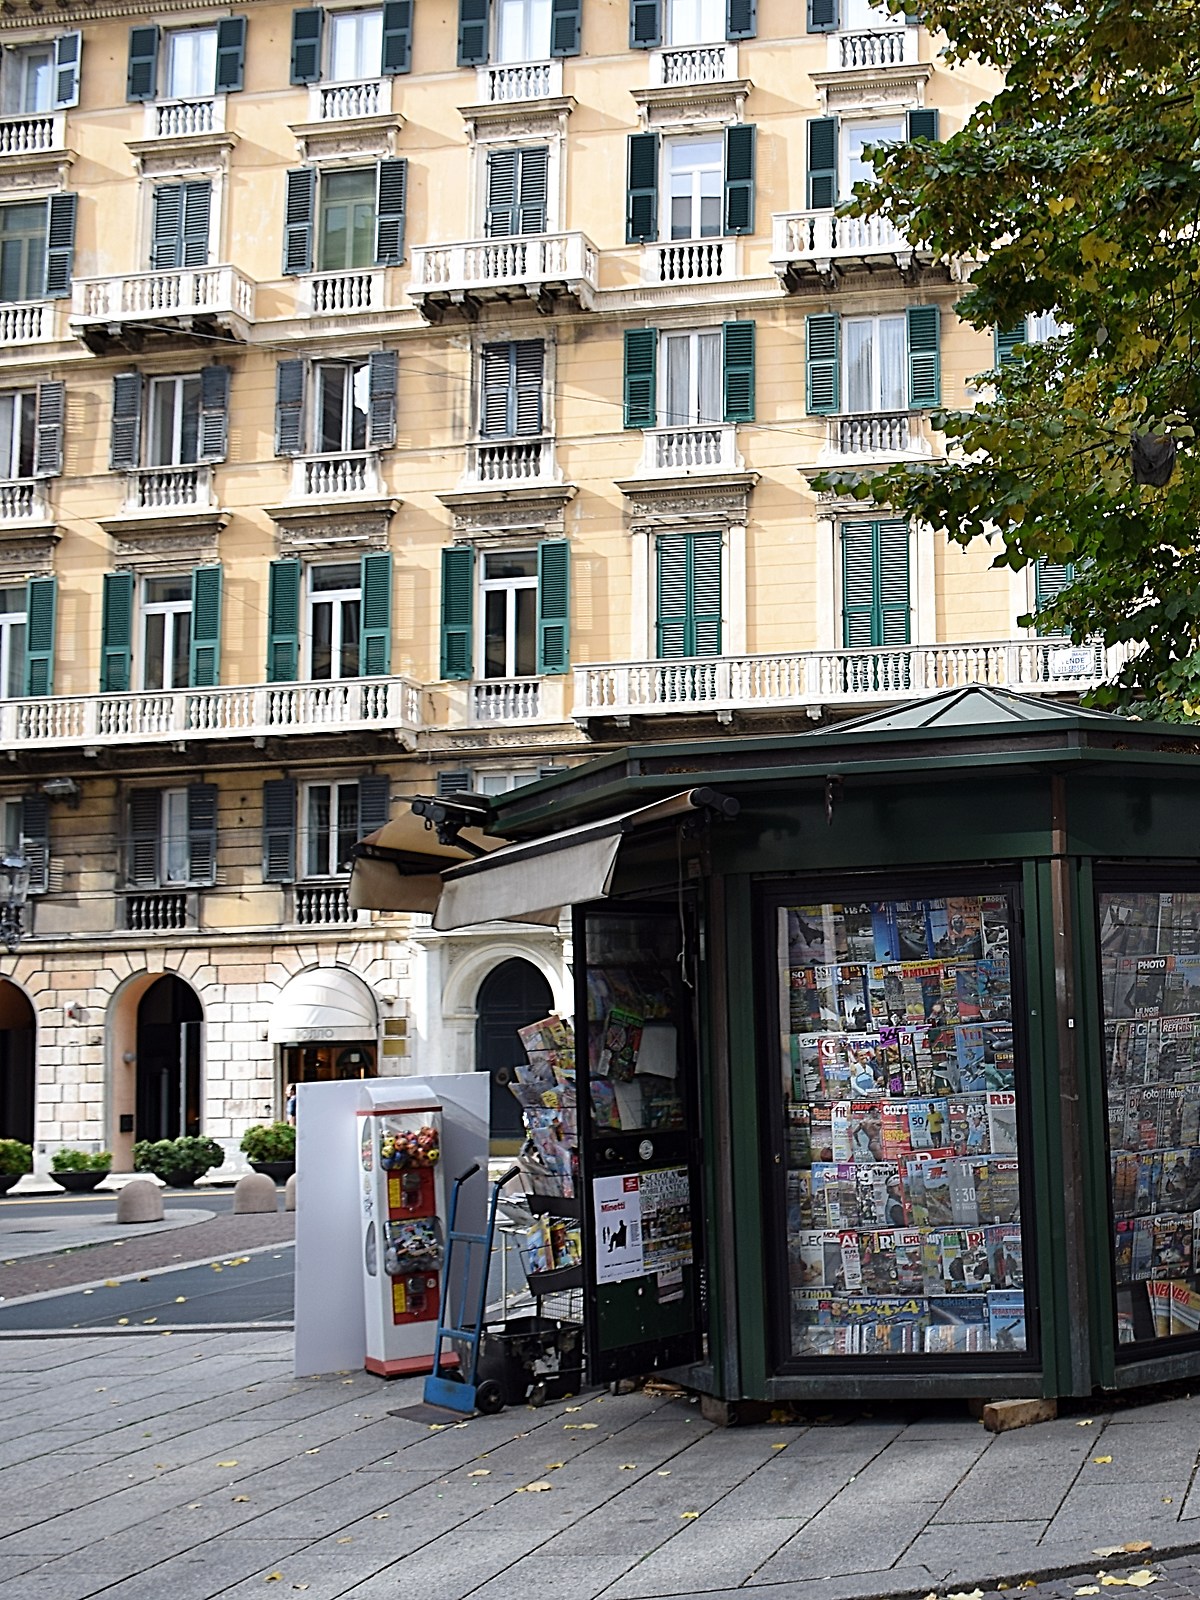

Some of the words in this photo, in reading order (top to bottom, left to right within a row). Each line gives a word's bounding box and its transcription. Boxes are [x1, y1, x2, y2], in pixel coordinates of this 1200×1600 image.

[1137, 959, 1166, 970] PHOTO
[835, 1105, 848, 1118] fit
[912, 1116, 924, 1126] 50
[962, 1187, 976, 1202] 30
[601, 1201, 626, 1212] Minetti
